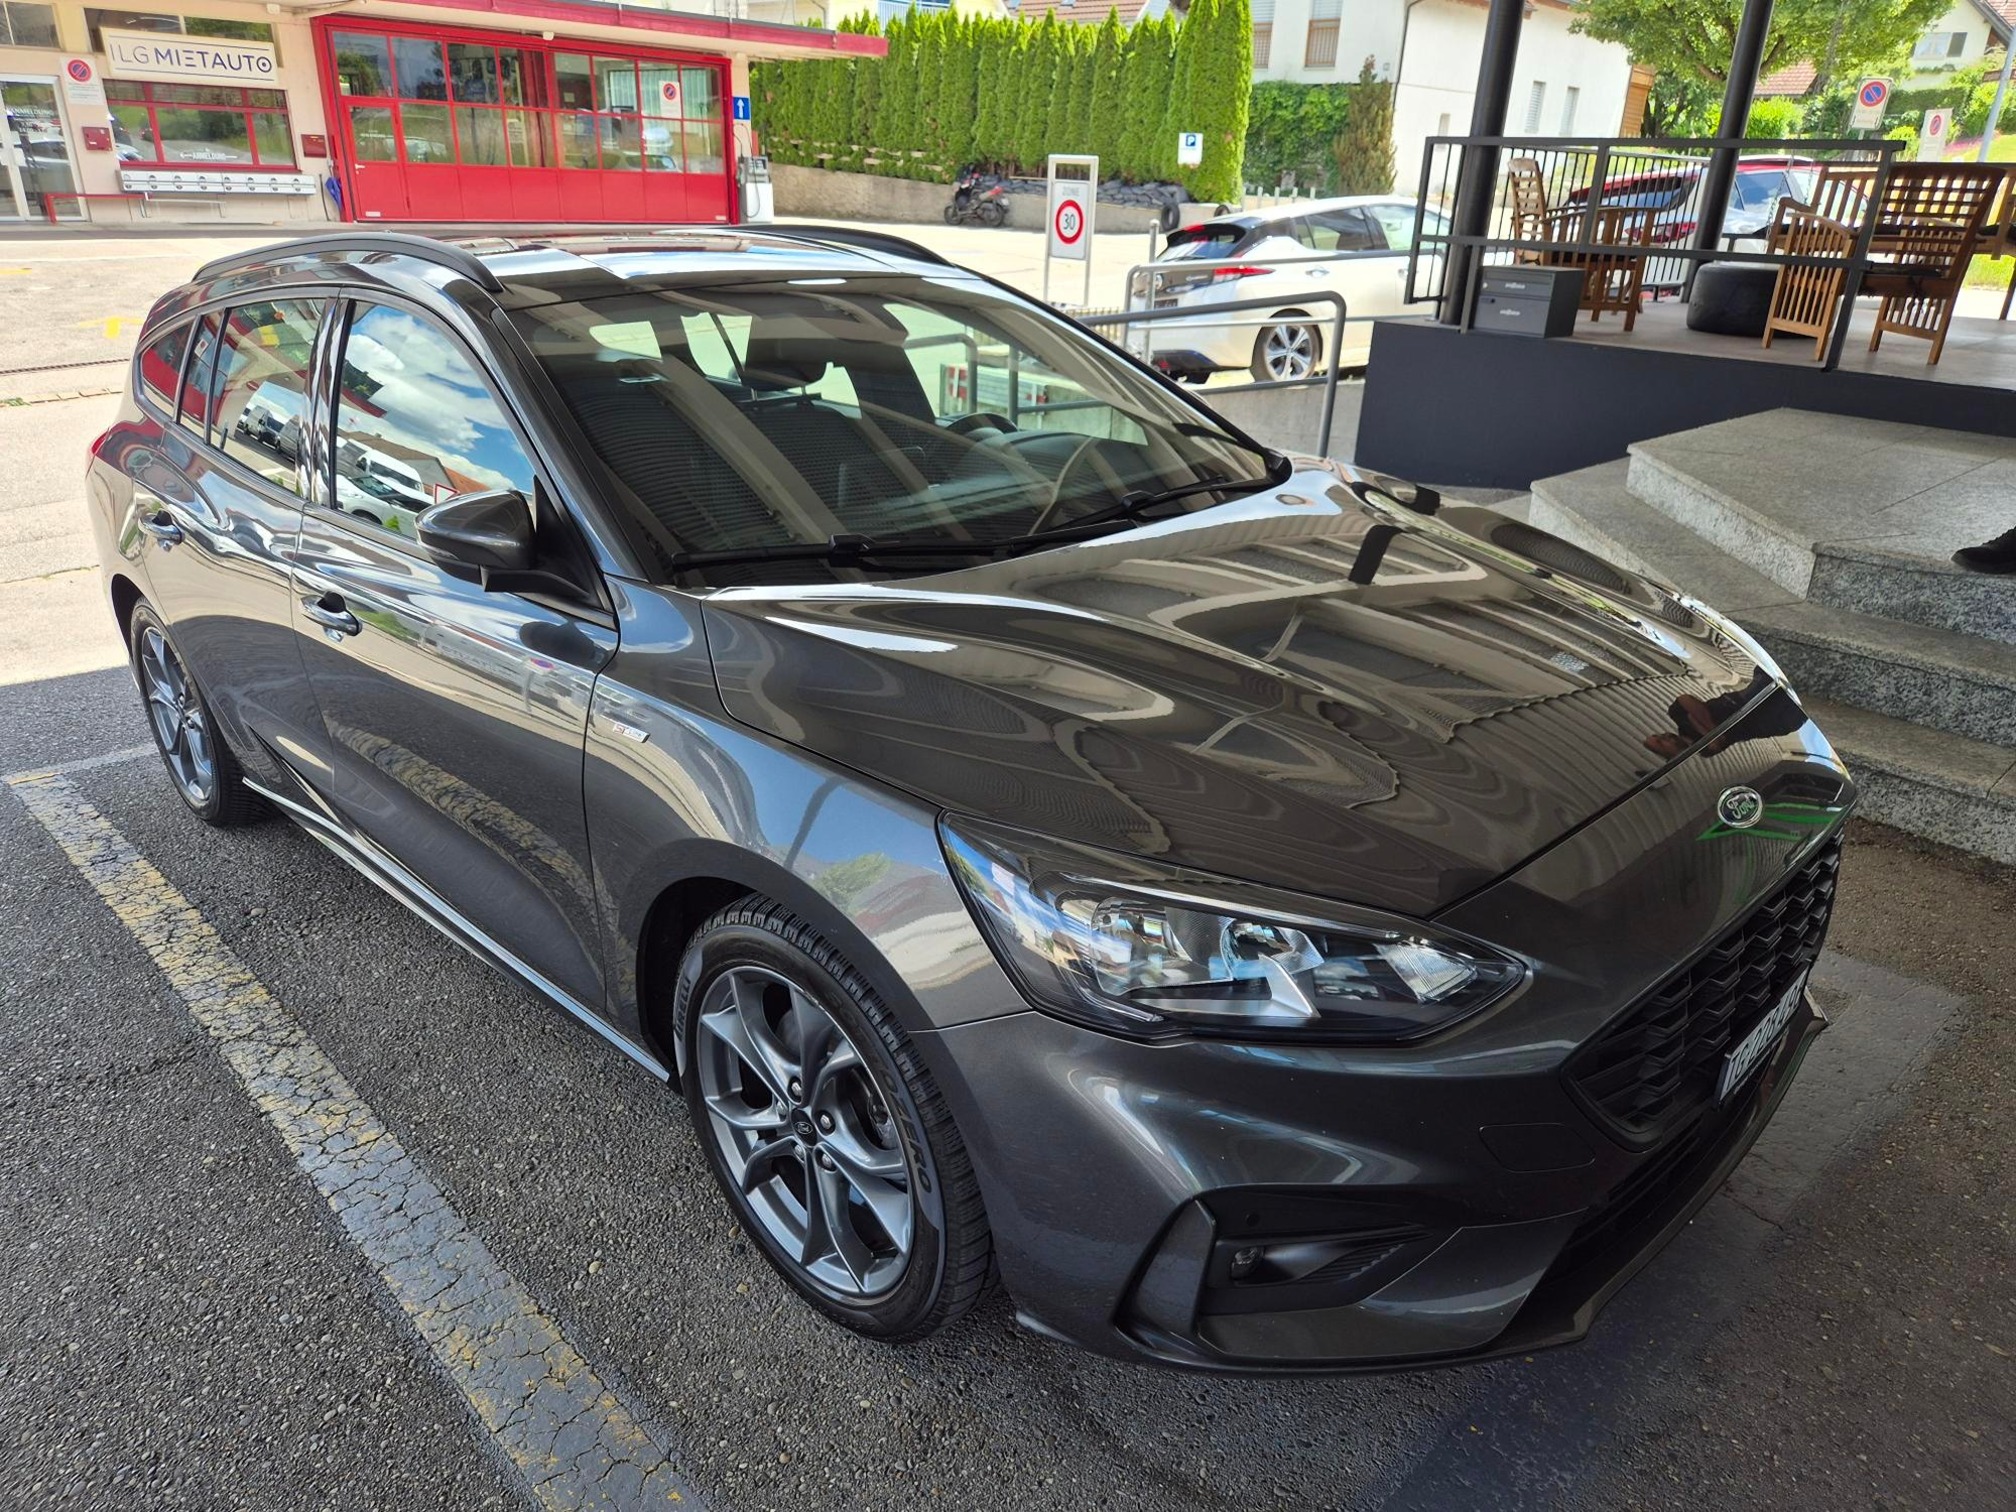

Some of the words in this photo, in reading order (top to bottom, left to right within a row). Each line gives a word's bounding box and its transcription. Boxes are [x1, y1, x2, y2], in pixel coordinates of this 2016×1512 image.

[110, 44, 149, 64] ILG
[154, 47, 272, 73] MIETAUTO
[1063, 213, 1076, 230] 30
